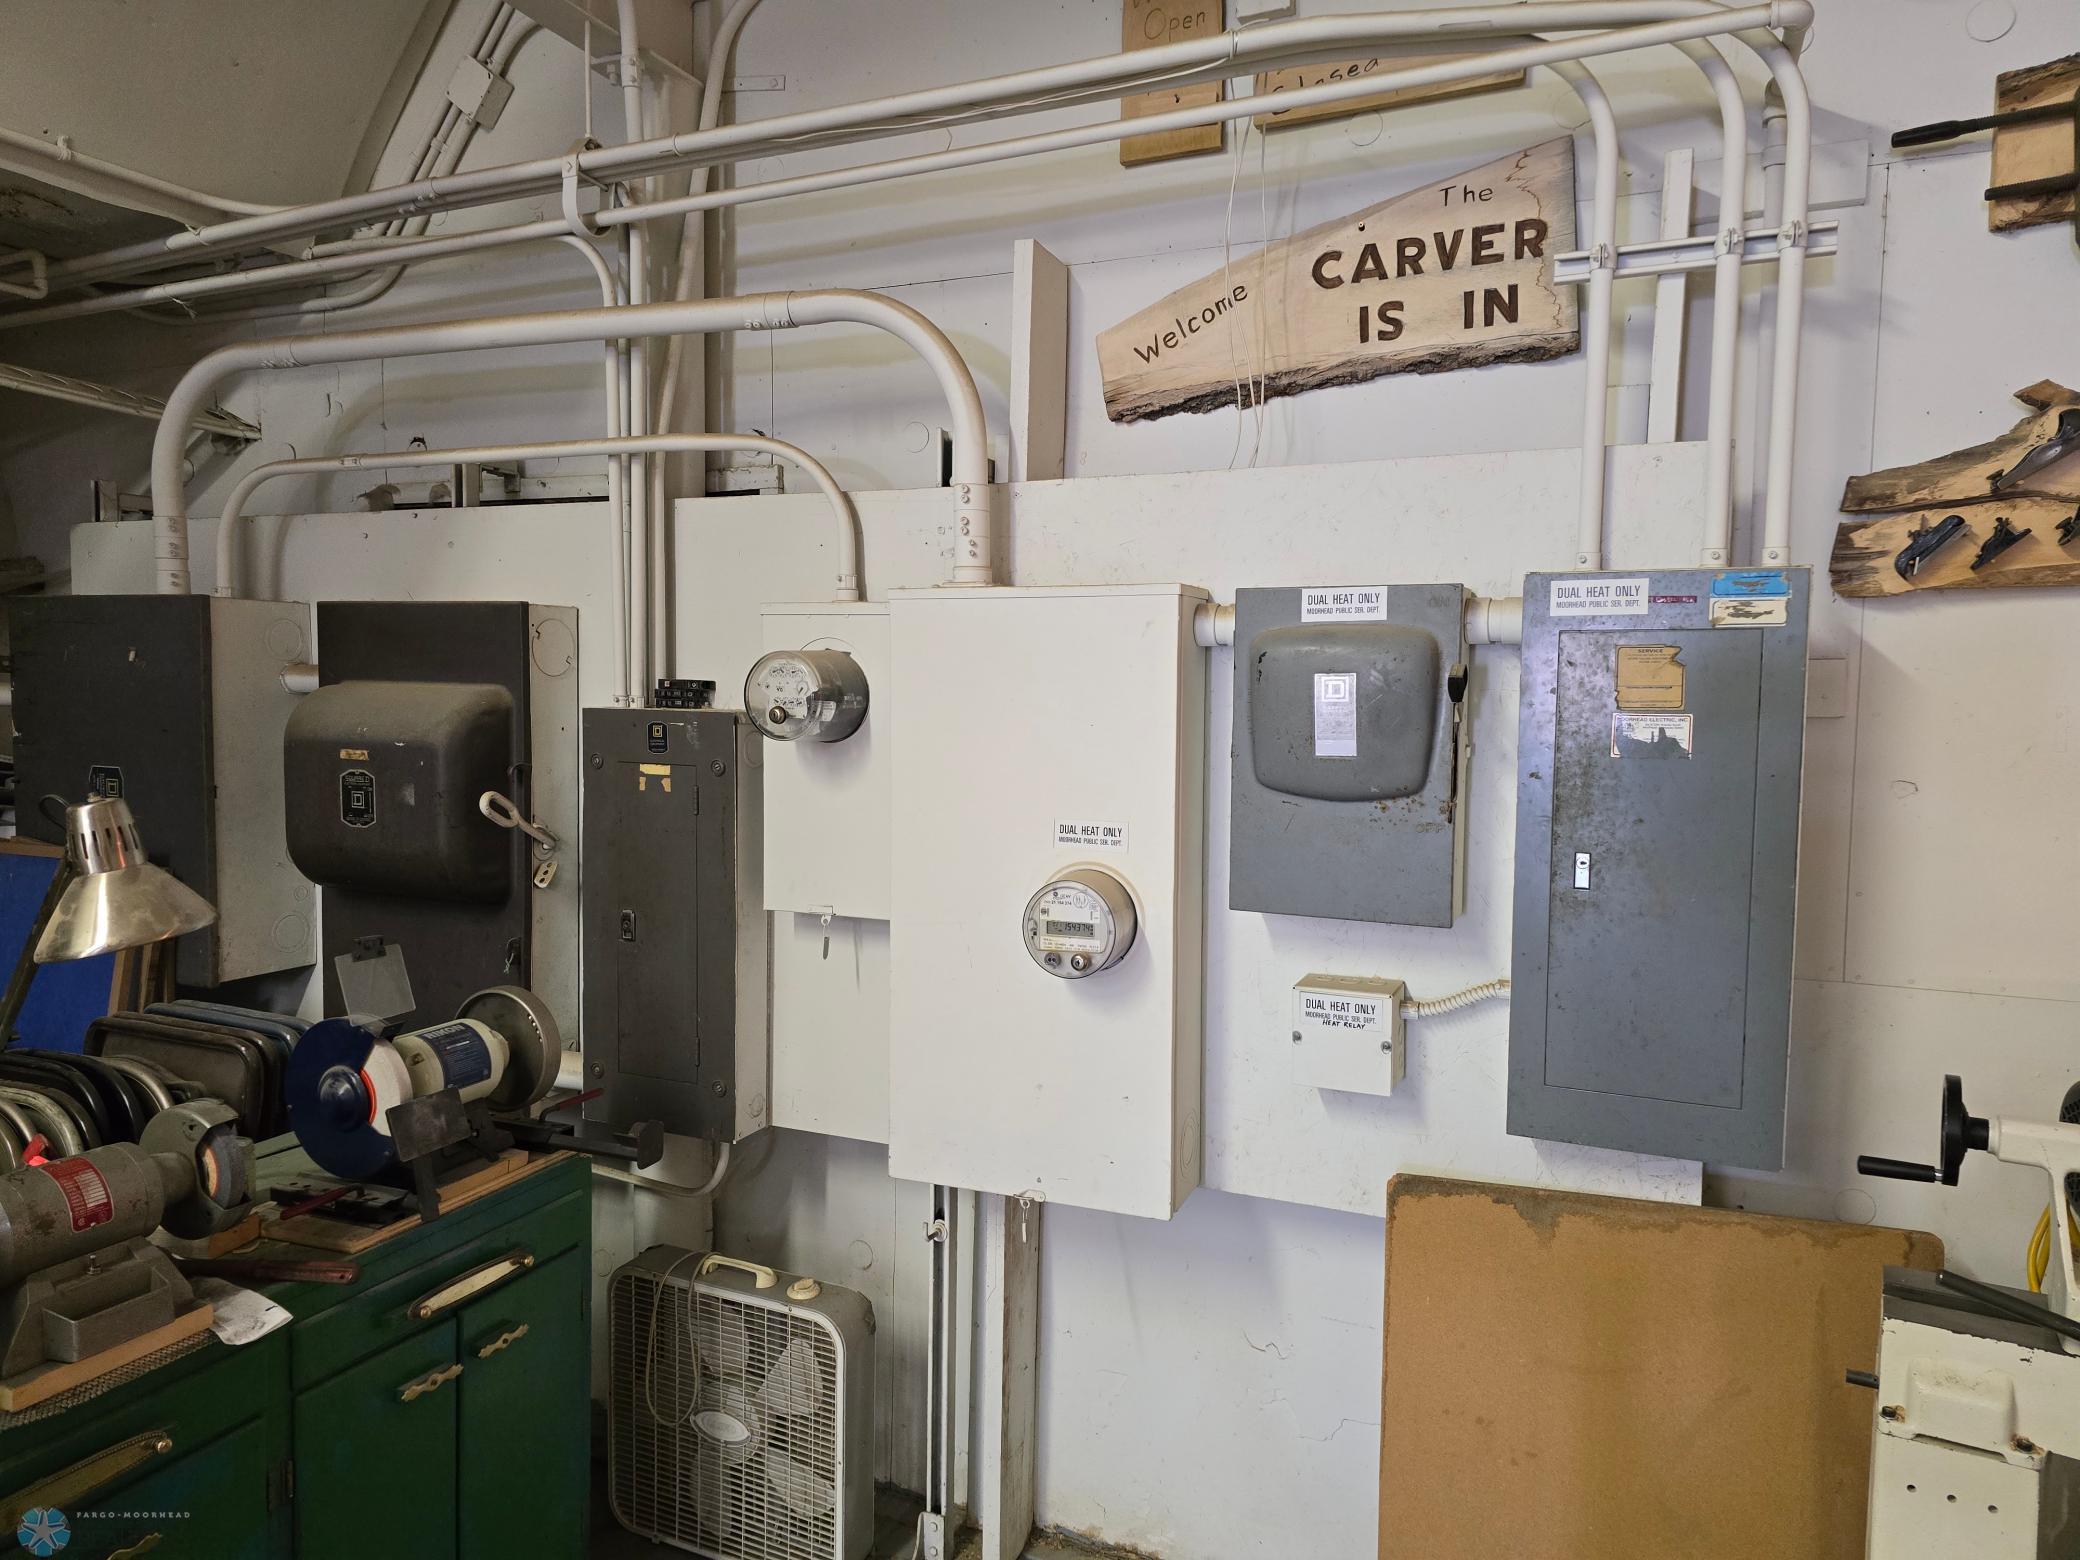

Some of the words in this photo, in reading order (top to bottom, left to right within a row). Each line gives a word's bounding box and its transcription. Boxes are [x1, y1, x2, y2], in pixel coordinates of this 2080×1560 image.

[1144, 7, 1206, 42] Open
[1439, 184, 1494, 207] The
[1311, 217, 1548, 290] CARVER
[1358, 300, 1405, 344] IS
[1463, 283, 1519, 329] IN
[1133, 283, 1249, 364] Welcome
[1307, 594, 1329, 606] DUAL
[1332, 593, 1354, 605] HEAT
[1358, 592, 1380, 604] ONLY
[1557, 587, 1581, 599] DUAL
[1586, 586, 1610, 598] HEAT
[1615, 585, 1641, 597] ONLY
[1306, 607, 1333, 615] MOORHEAD
[1354, 606, 1365, 614] SER.
[1556, 600, 1587, 609] MOORHEAD
[1588, 600, 1609, 608] PUBLIC
[1610, 600, 1622, 608] SER.
[1624, 599, 1641, 607] DEPT.
[1059, 824, 1078, 835] DUAL
[1081, 825, 1100, 836] HEAT
[1103, 826, 1122, 838] ONLY
[1058, 836, 1082, 844] MOORHEAD
[1083, 837, 1099, 845] PUBLIC
[1305, 998, 1326, 1010] DUAL
[1330, 1001, 1350, 1013] HEAT
[1354, 1003, 1376, 1015] ONLY
[1305, 1011, 1331, 1020] MOORHEAD
[1332, 1013, 1349, 1022] PUBLIC
[1351, 1015, 1361, 1023] SER.
[1363, 1016, 1376, 1025] DEPT.
[1322, 1019, 1340, 1027] HEAT
[1343, 1021, 1365, 1030] RELAY
